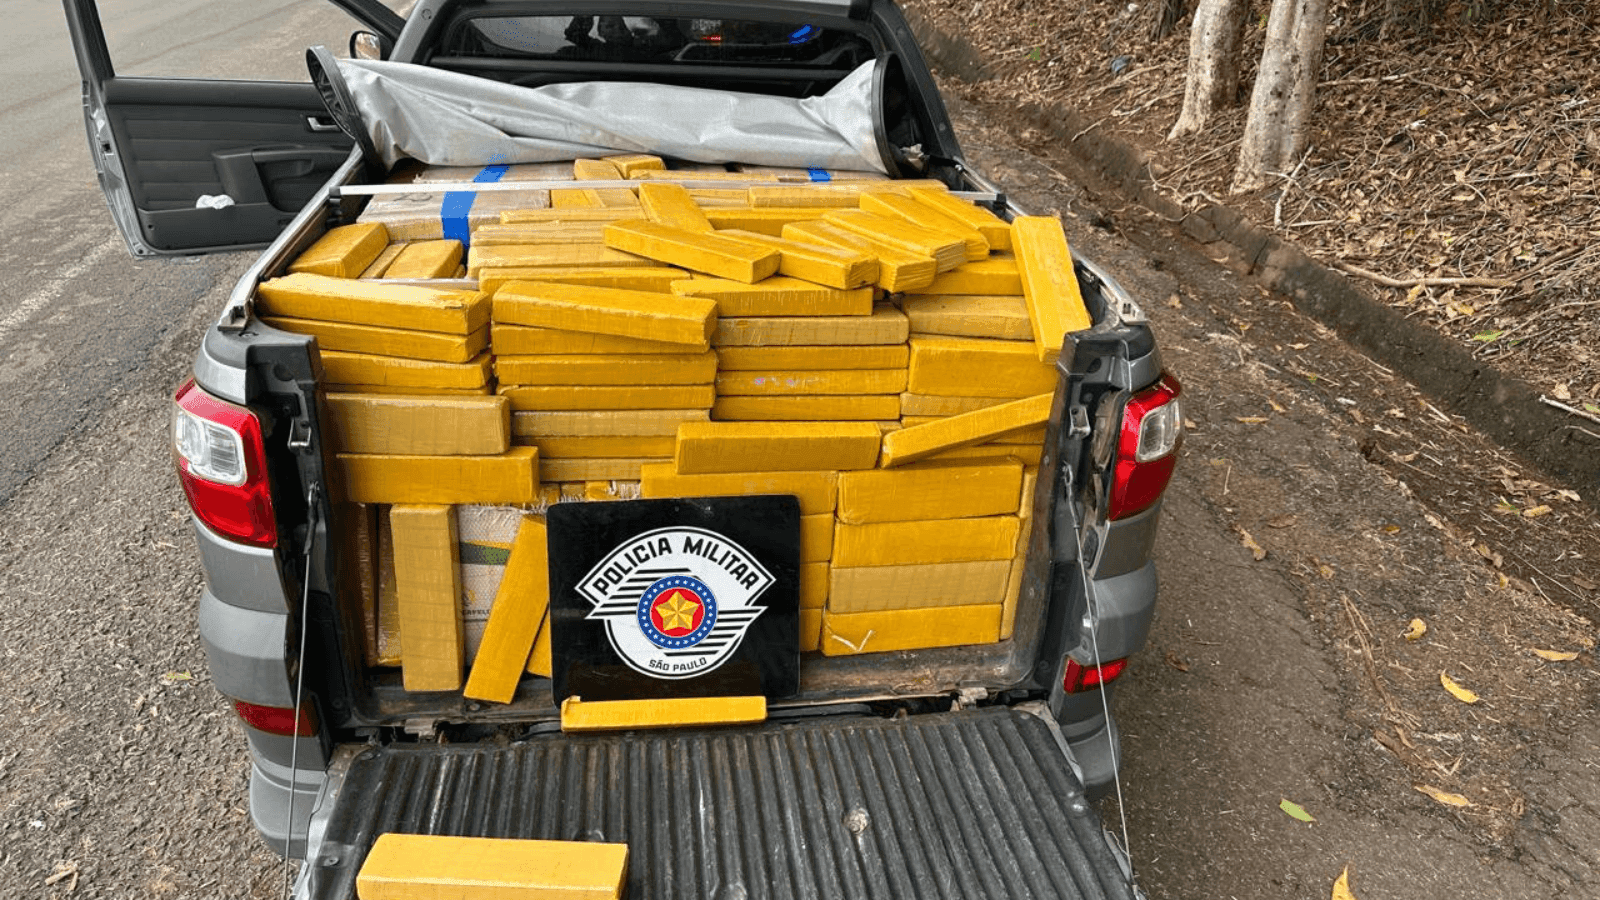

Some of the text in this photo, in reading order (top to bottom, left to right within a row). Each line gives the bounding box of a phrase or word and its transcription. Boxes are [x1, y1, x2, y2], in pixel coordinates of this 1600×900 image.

[592, 536, 760, 596] POLICIA MILITAR
[648, 657, 707, 672] SÃO PAULO
